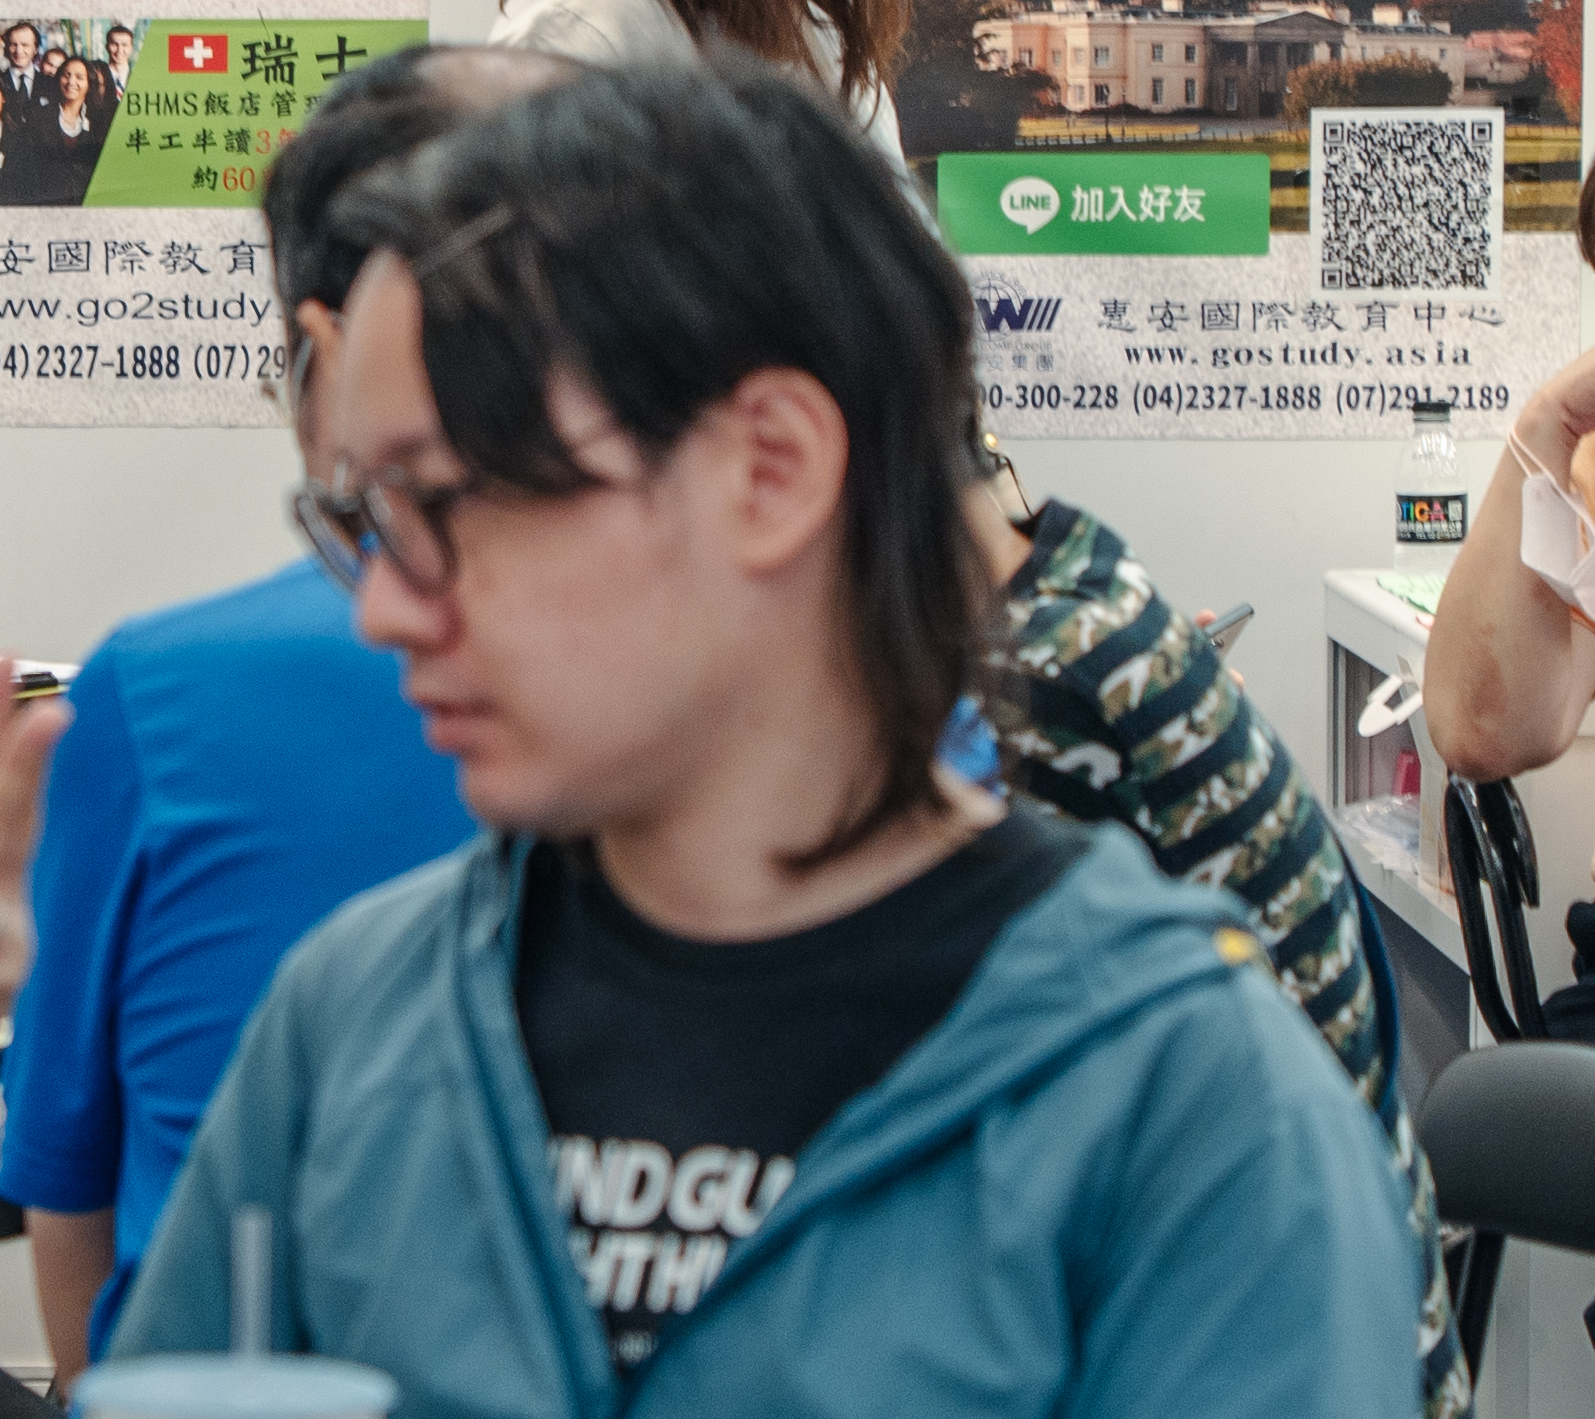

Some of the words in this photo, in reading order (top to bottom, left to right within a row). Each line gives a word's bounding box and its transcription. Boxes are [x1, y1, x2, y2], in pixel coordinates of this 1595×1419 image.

[241, 33, 368, 88] 瑞士
[192, 165, 273, 194] 約60
[1008, 194, 1052, 212] LINE
[1070, 183, 1207, 224] 加入好友
[1097, 297, 1506, 333] 惠安國際教育中心
[1124, 340, 1473, 370] www.gostudy.asia
[1133, 382, 1322, 416] (04)2327-1888
